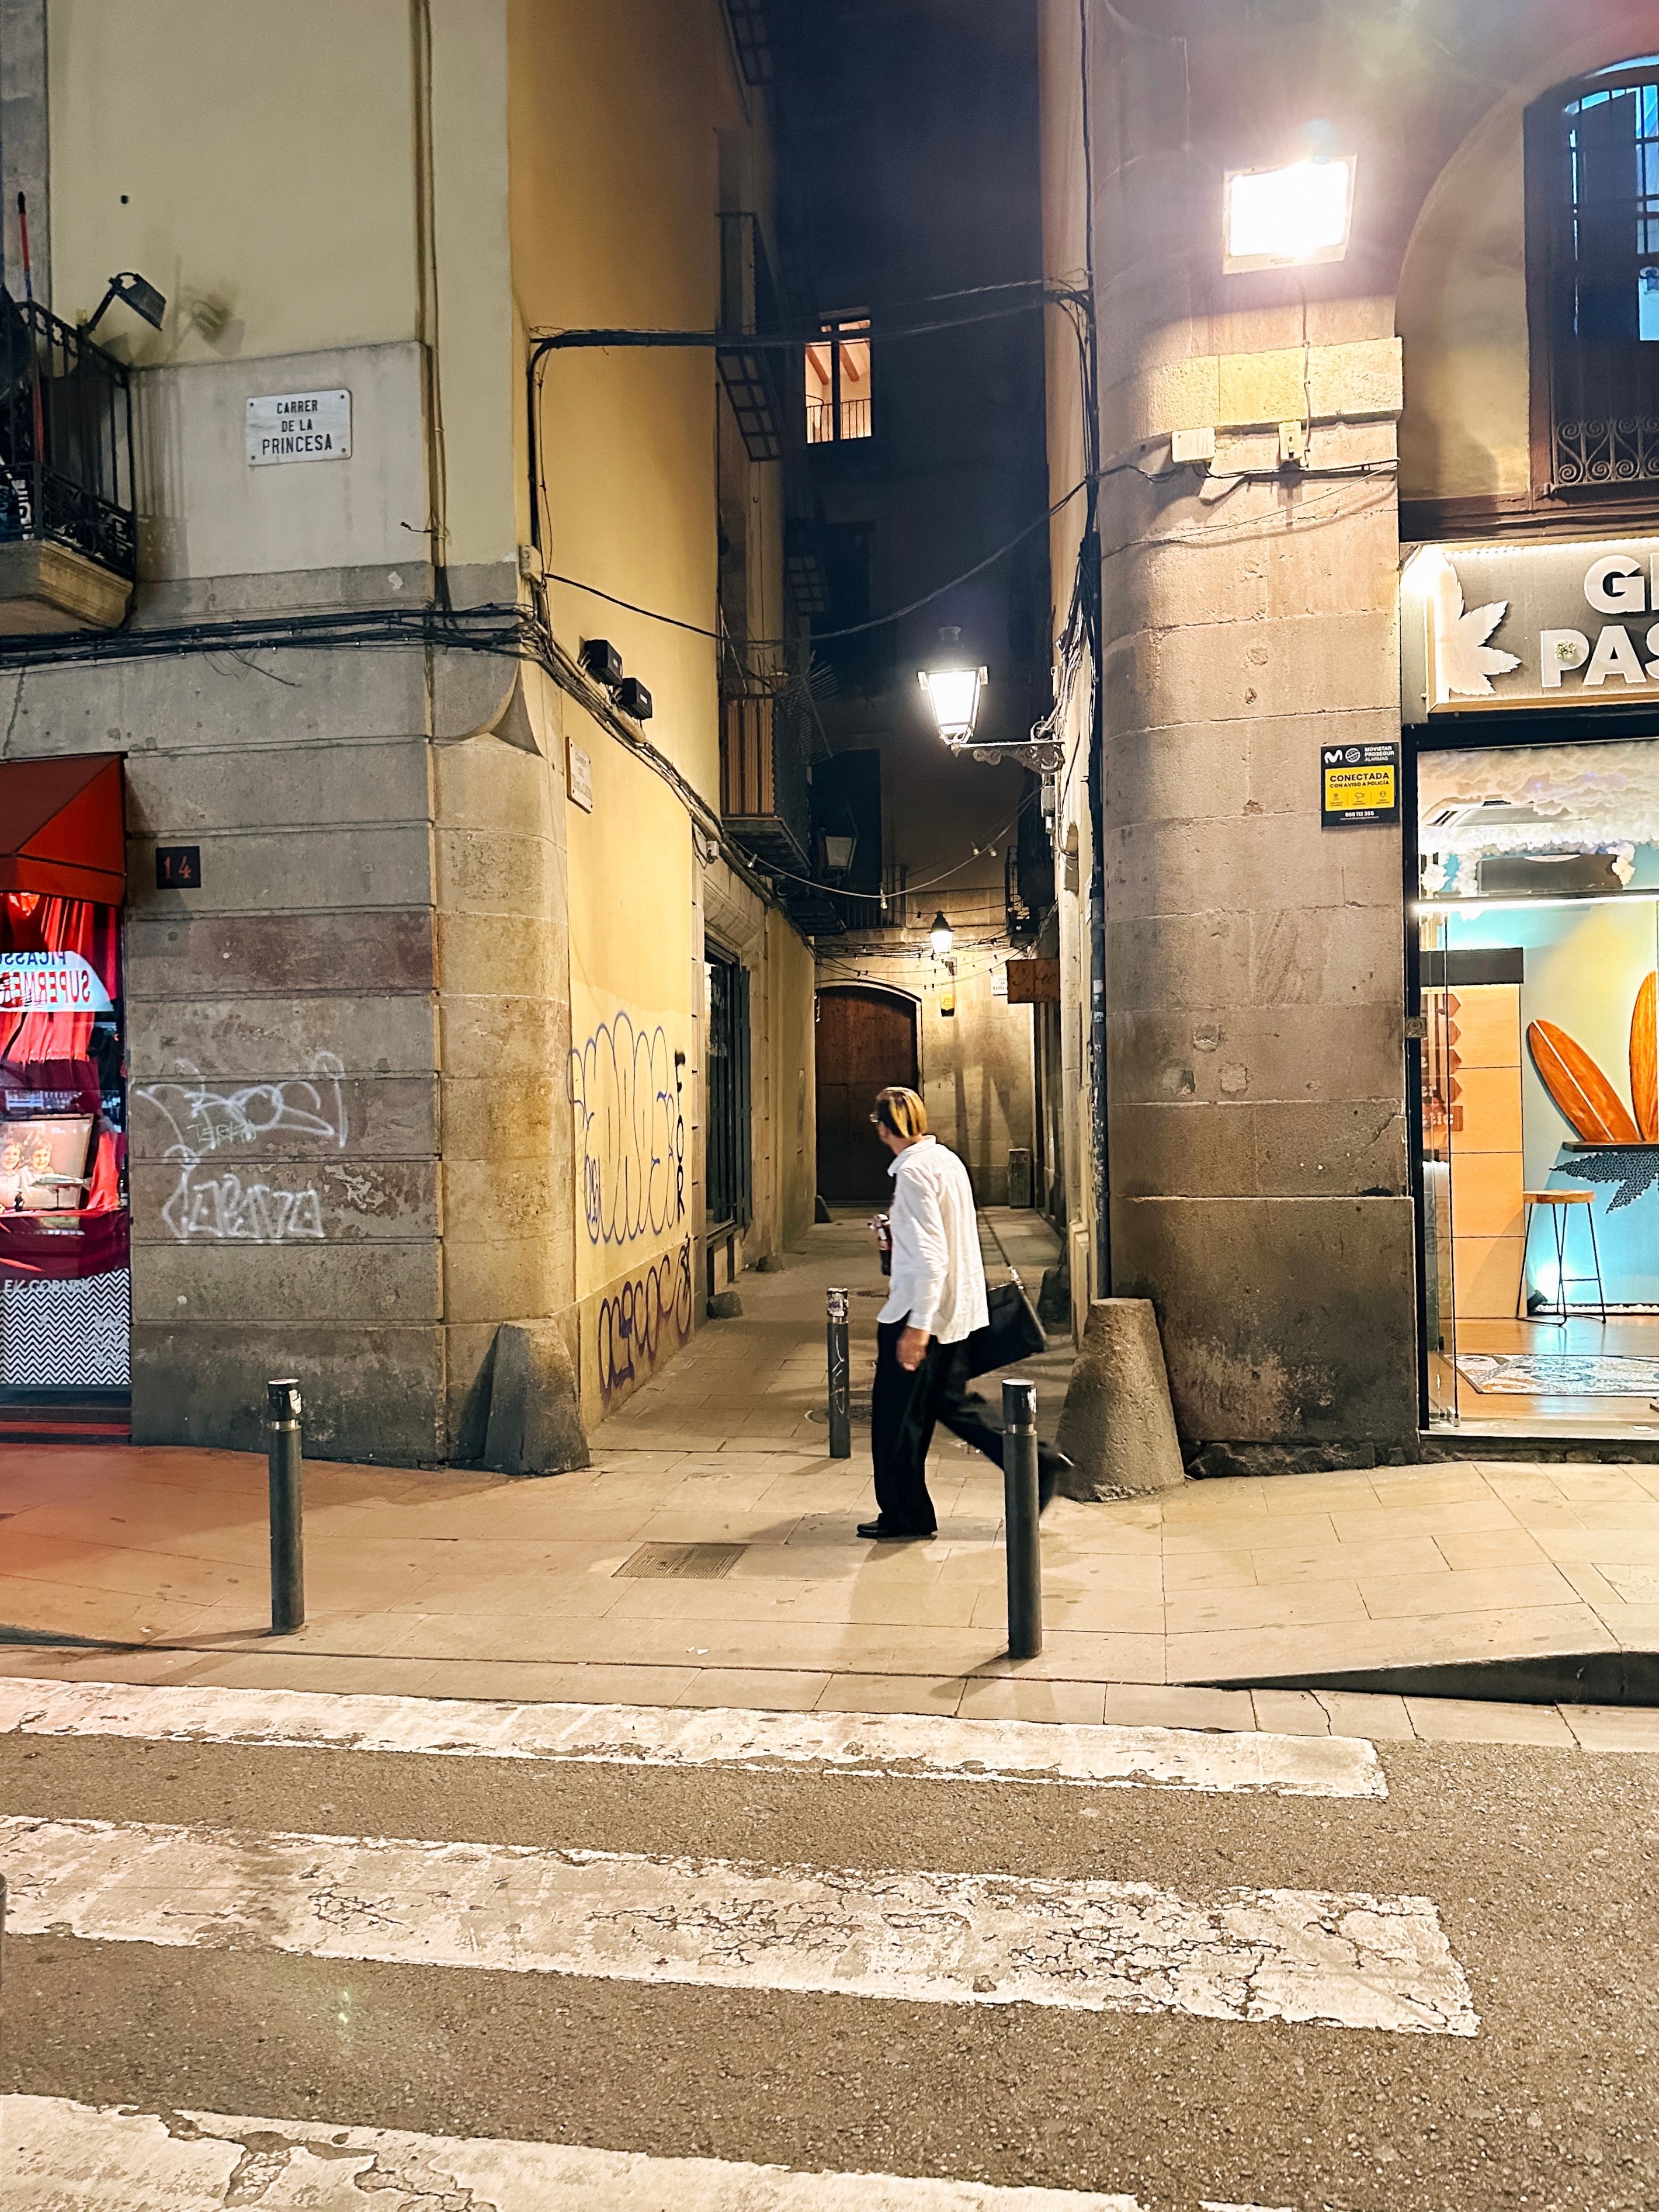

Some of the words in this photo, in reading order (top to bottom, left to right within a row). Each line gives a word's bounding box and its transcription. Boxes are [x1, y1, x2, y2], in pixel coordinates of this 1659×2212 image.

[277, 400, 318, 414] CARRER
[282, 420, 294, 432] DE
[299, 418, 313, 431] LA
[262, 433, 332, 455] PRINCESA
[1330, 772, 1389, 782] CONECTADA
[164, 856, 192, 878] 14
